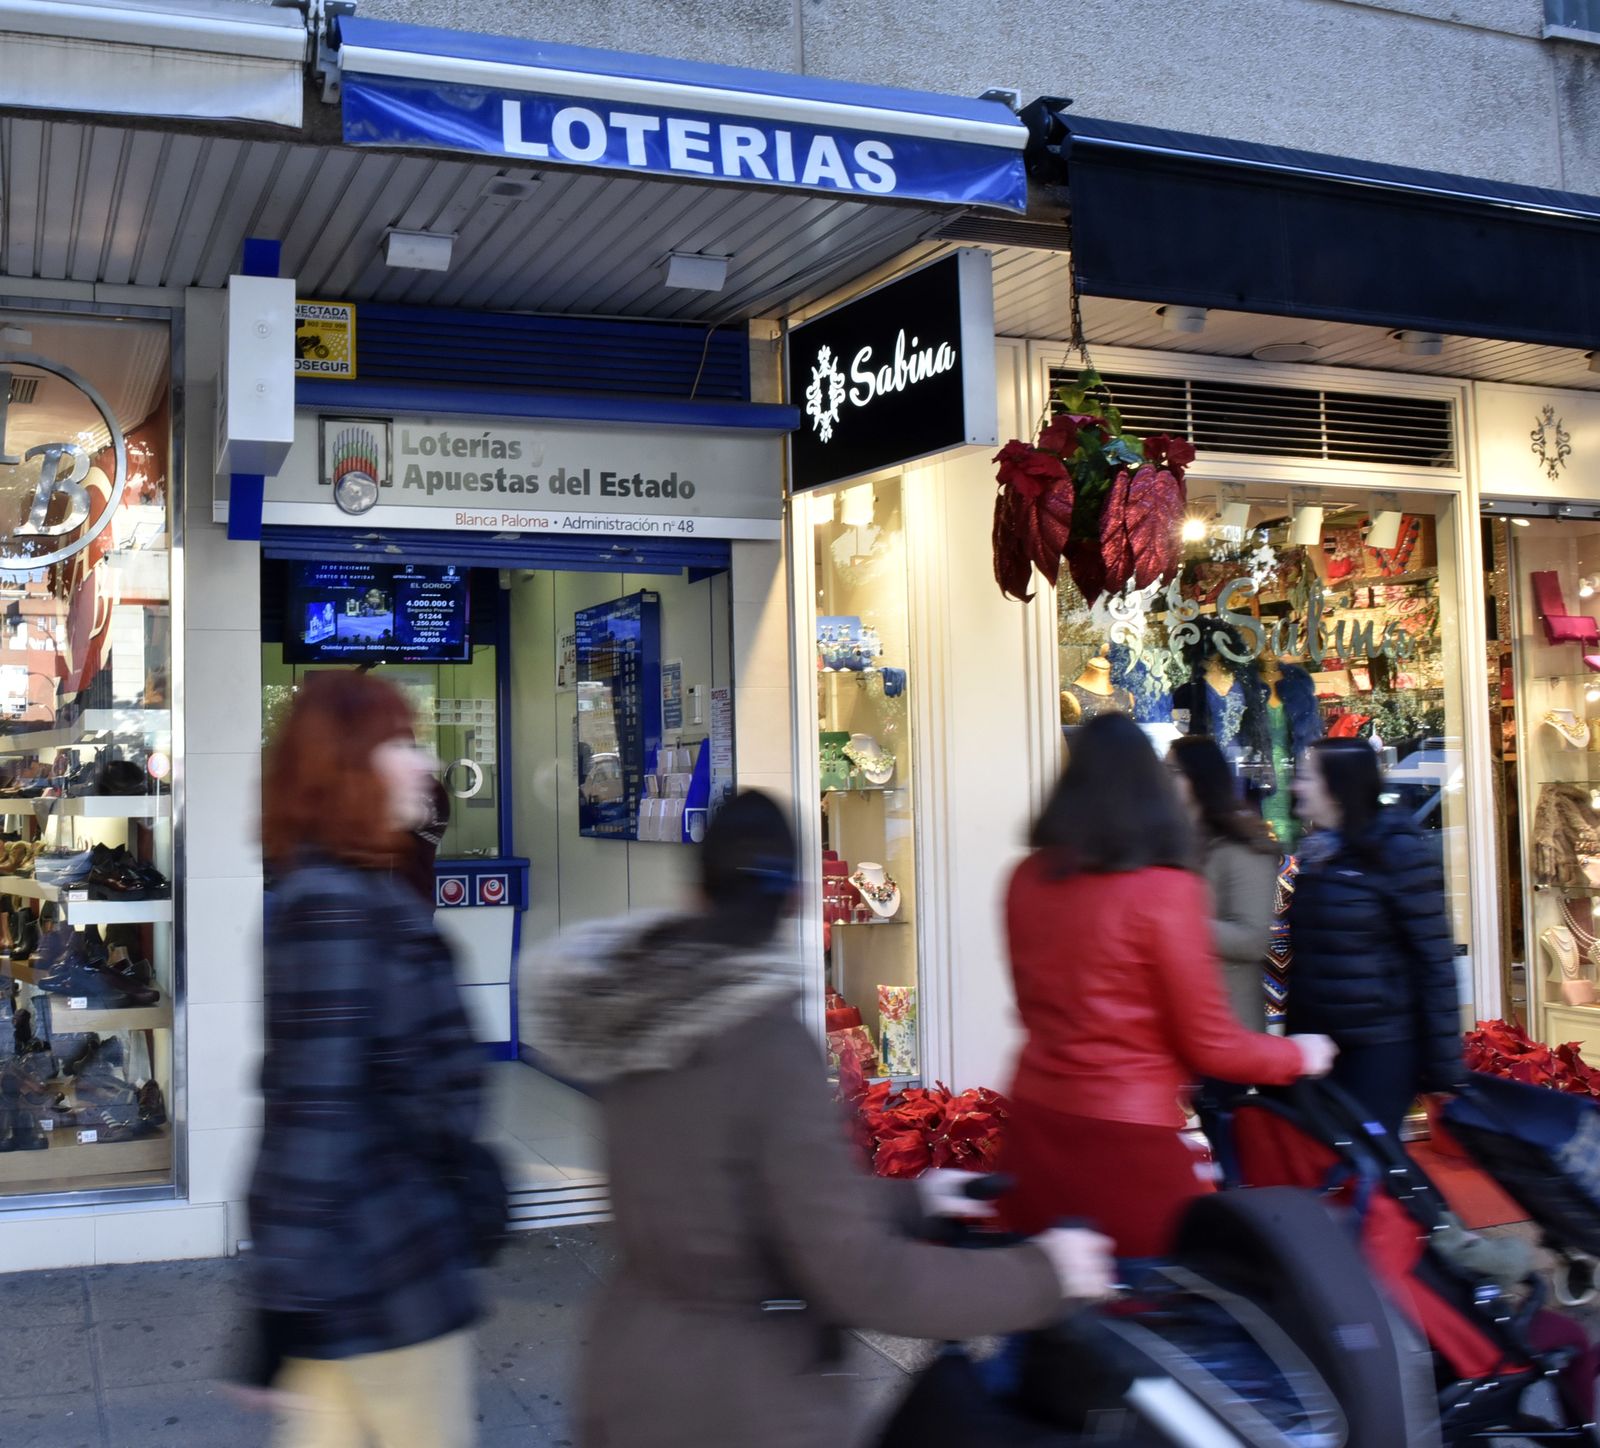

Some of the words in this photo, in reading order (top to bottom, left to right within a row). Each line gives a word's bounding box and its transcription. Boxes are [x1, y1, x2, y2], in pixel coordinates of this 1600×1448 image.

[502, 99, 897, 194] LOTERIAS
[849, 328, 956, 407] Sabina
[401, 429, 522, 460] Loterías
[402, 463, 539, 496] Apuestas
[549, 467, 591, 496] del
[600, 471, 696, 499] Estado
[455, 512, 497, 526] Blanca
[501, 514, 549, 528] Paloma
[562, 516, 659, 532] Administración
[678, 520, 694, 533] 48
[1212, 576, 1415, 663] Sabina
